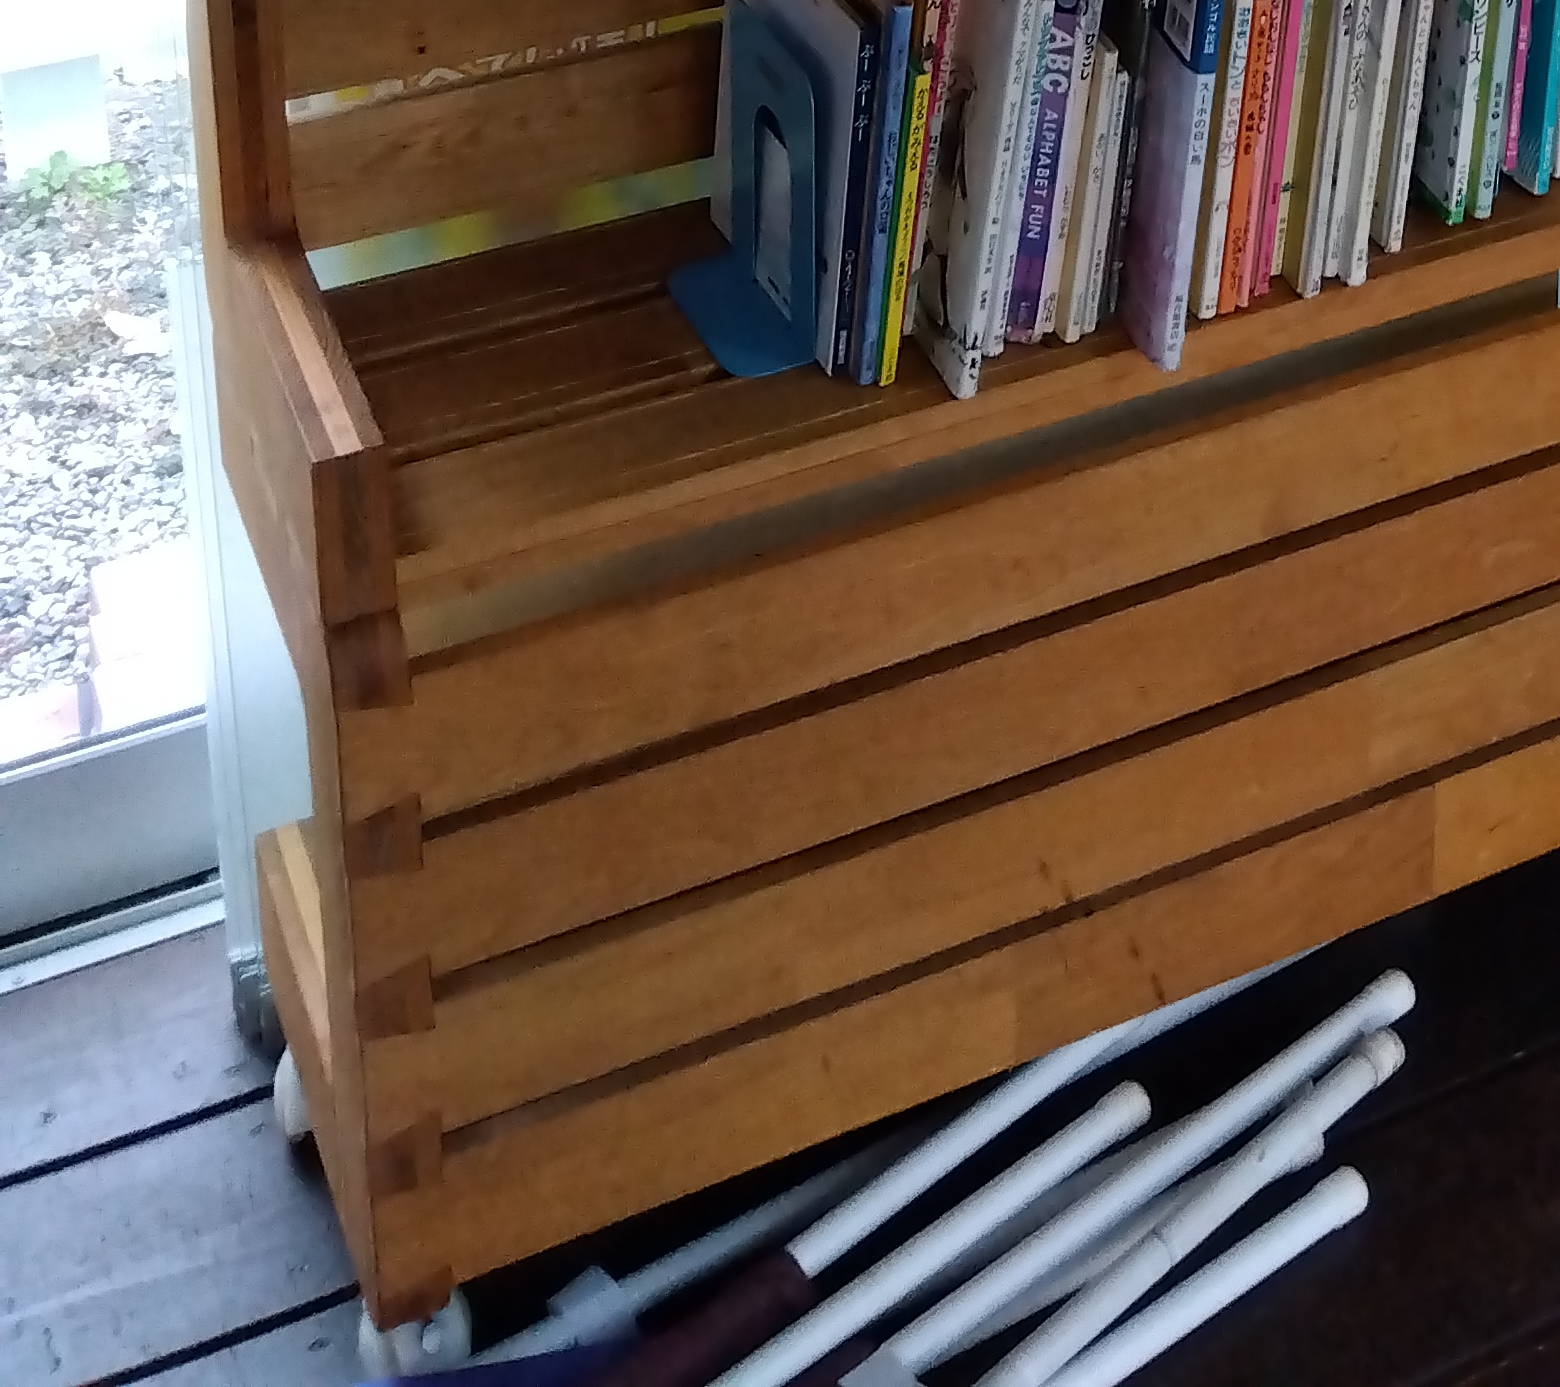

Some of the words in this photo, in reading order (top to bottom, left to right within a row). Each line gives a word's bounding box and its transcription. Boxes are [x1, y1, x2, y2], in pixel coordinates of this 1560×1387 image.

[1041, 26, 1076, 95] ABC
[1032, 107, 1059, 197] ALPHABET
[1189, 81, 1211, 166] スーホの白い馬
[1025, 204, 1045, 240] FUN
